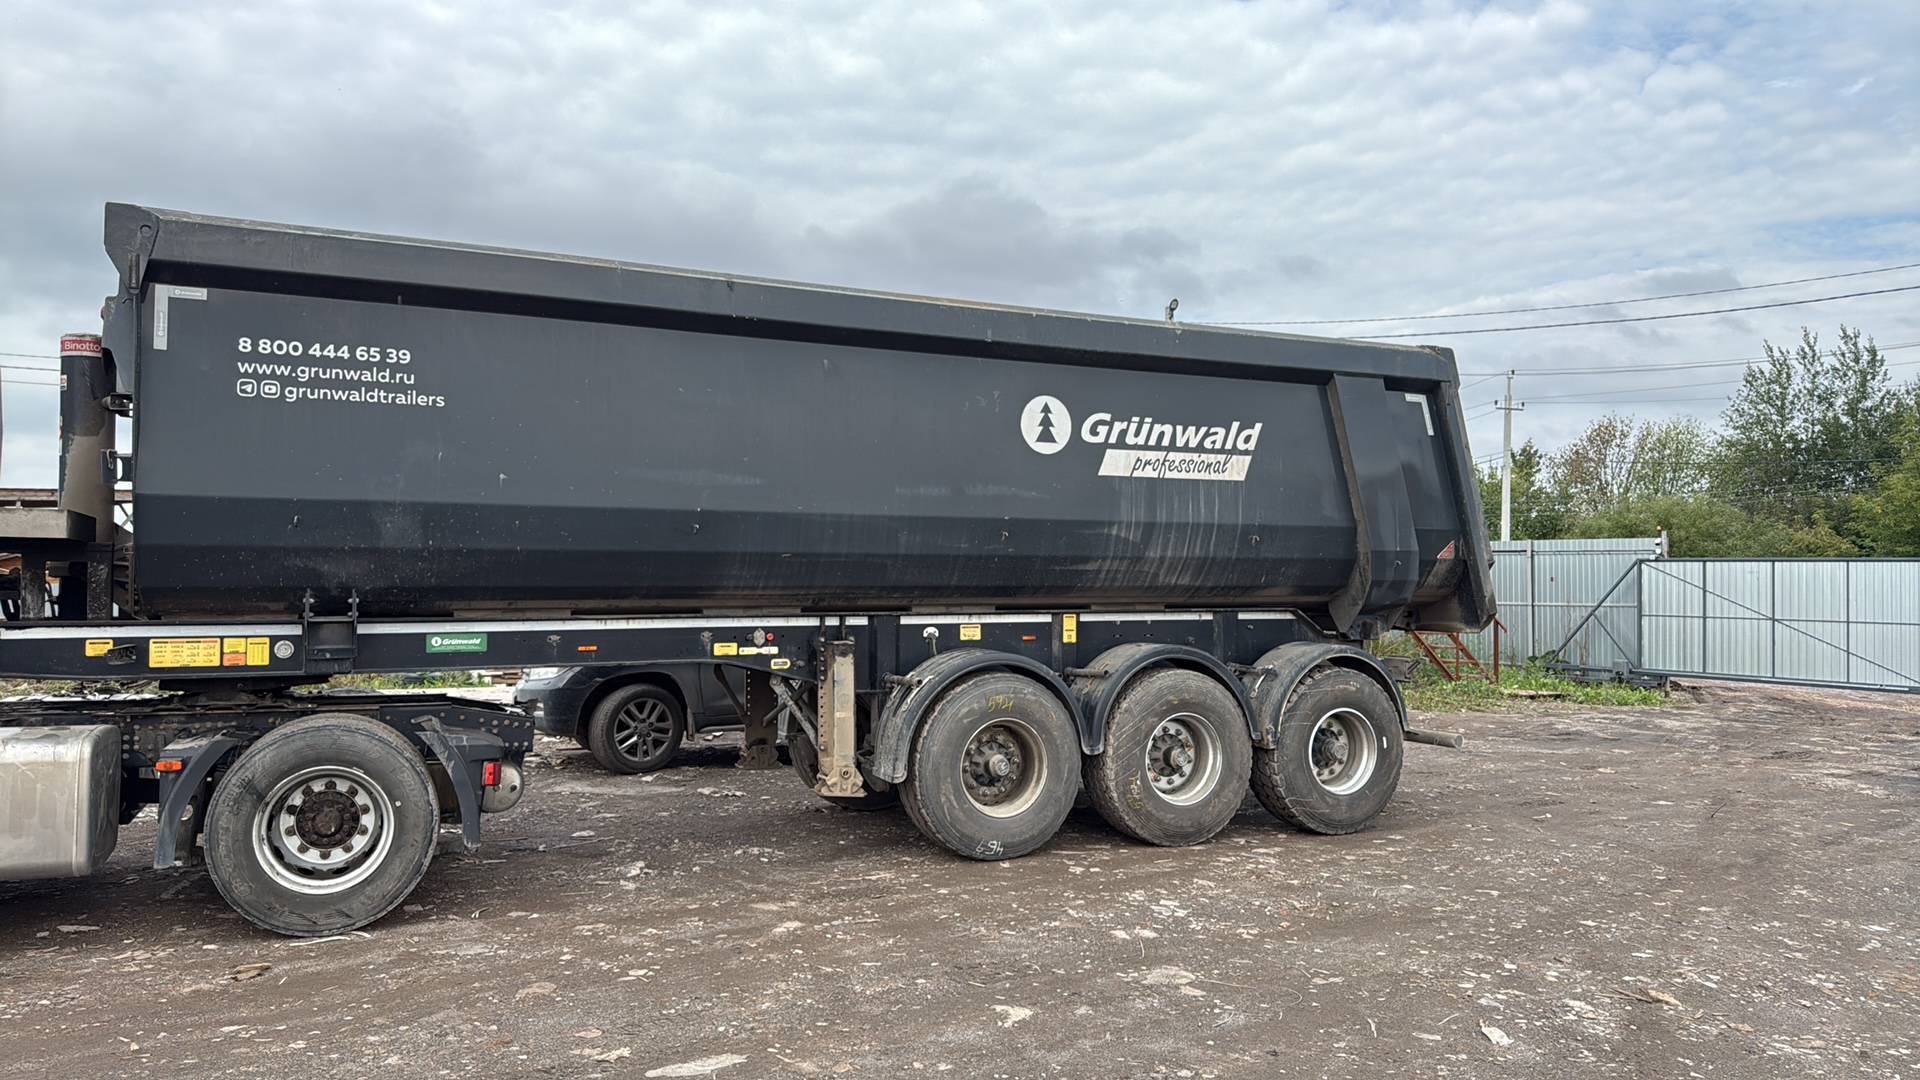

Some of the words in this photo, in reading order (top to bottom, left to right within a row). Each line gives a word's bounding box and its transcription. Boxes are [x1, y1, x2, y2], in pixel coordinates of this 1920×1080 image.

[64, 341, 101, 352] Binotto
[238, 337, 252, 352] 8
[257, 339, 303, 356] 800
[308, 343, 350, 360] 444
[355, 346, 381, 362] 65
[386, 349, 411, 364] 39
[237, 361, 415, 384] www.grunwald.ru
[284, 387, 446, 407] grunwaldtrailers
[1080, 412, 1263, 451] Grünwald
[1130, 451, 1232, 479] professional
